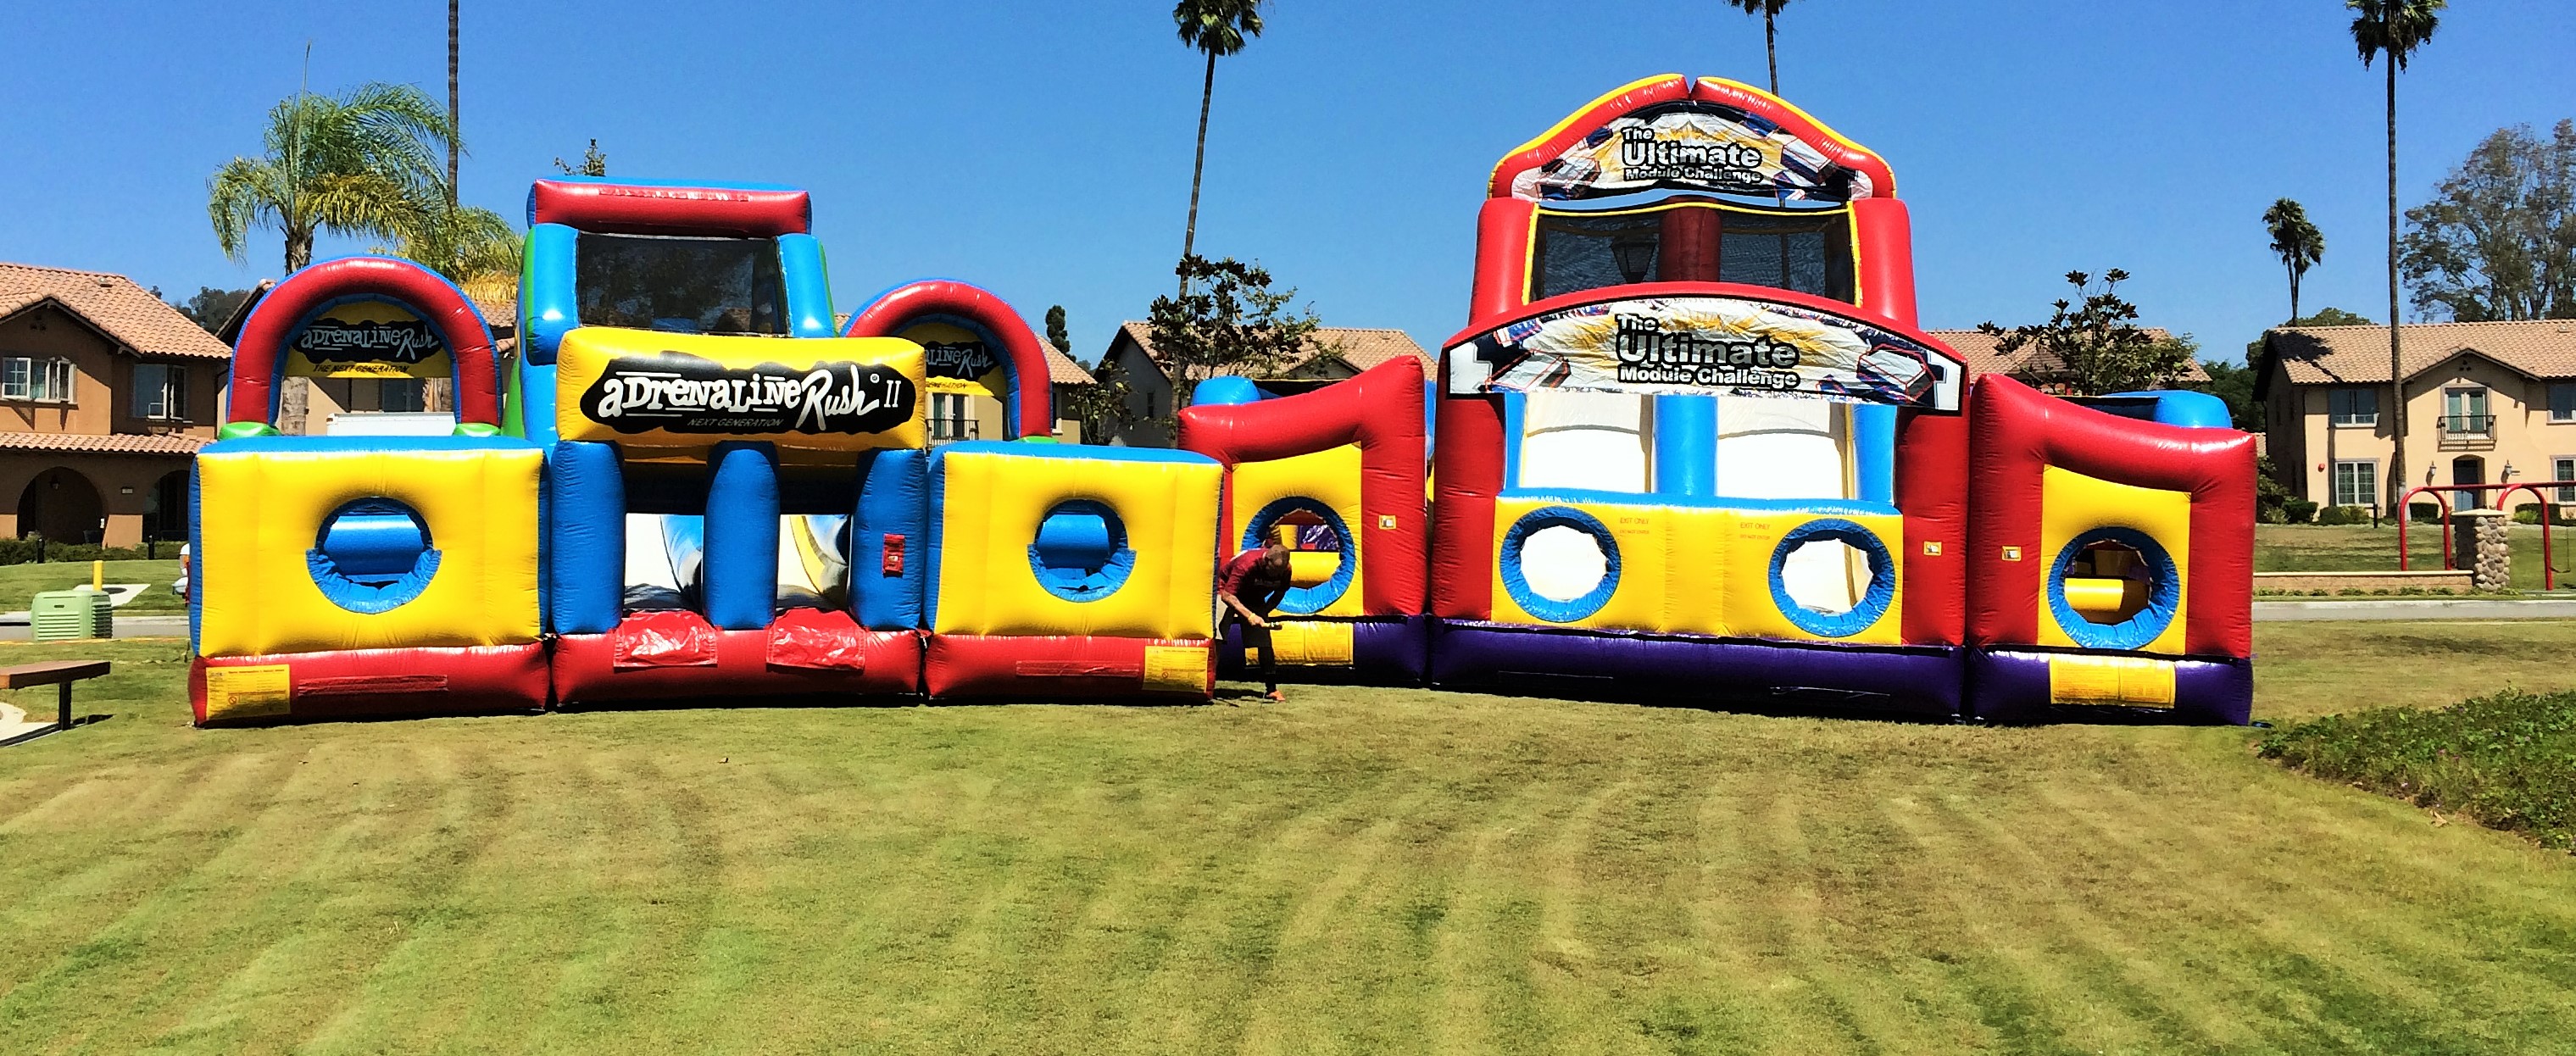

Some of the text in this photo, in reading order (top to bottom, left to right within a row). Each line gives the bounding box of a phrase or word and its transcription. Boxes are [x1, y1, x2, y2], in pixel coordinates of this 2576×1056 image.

[1622, 127, 1653, 140] The
[1623, 141, 1761, 167] Ultimate
[1626, 166, 1761, 183] Module Challenge
[1617, 314, 1656, 331] The
[1619, 333, 1796, 366] Ultimate
[1620, 366, 1798, 389] Module Challenge
[687, 418, 784, 427] NEXT GENERATION
